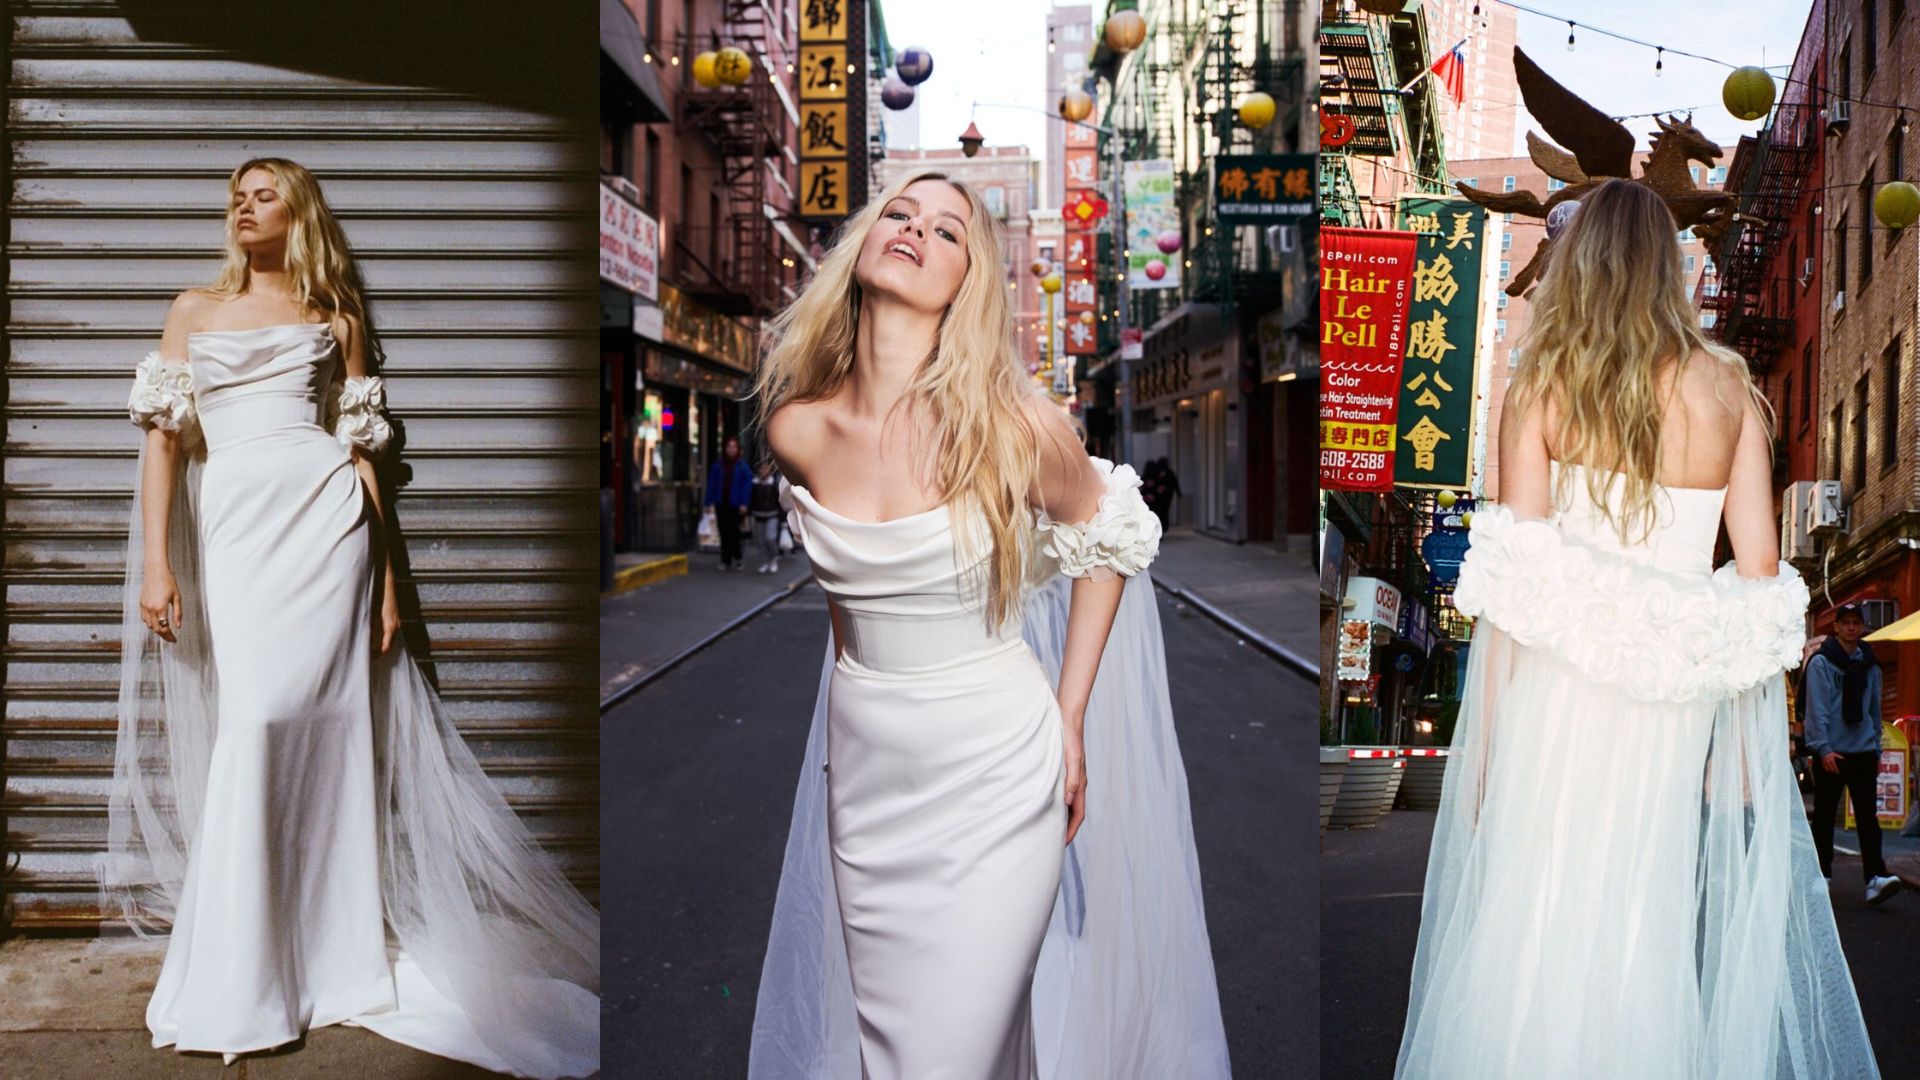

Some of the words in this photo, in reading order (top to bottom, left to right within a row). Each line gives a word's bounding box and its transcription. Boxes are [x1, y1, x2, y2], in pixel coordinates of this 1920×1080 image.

[1320, 249, 1398, 265] 18Pell.com
[1321, 267, 1391, 294] Hair
[1334, 295, 1372, 320] Le
[1388, 280, 1405, 358] 18Pell.com
[1321, 321, 1377, 348] Pell
[1328, 373, 1361, 388] Color
[1328, 391, 1345, 403] Hair
[1345, 392, 1393, 410] Straightening
[1335, 406, 1381, 421] Treatment
